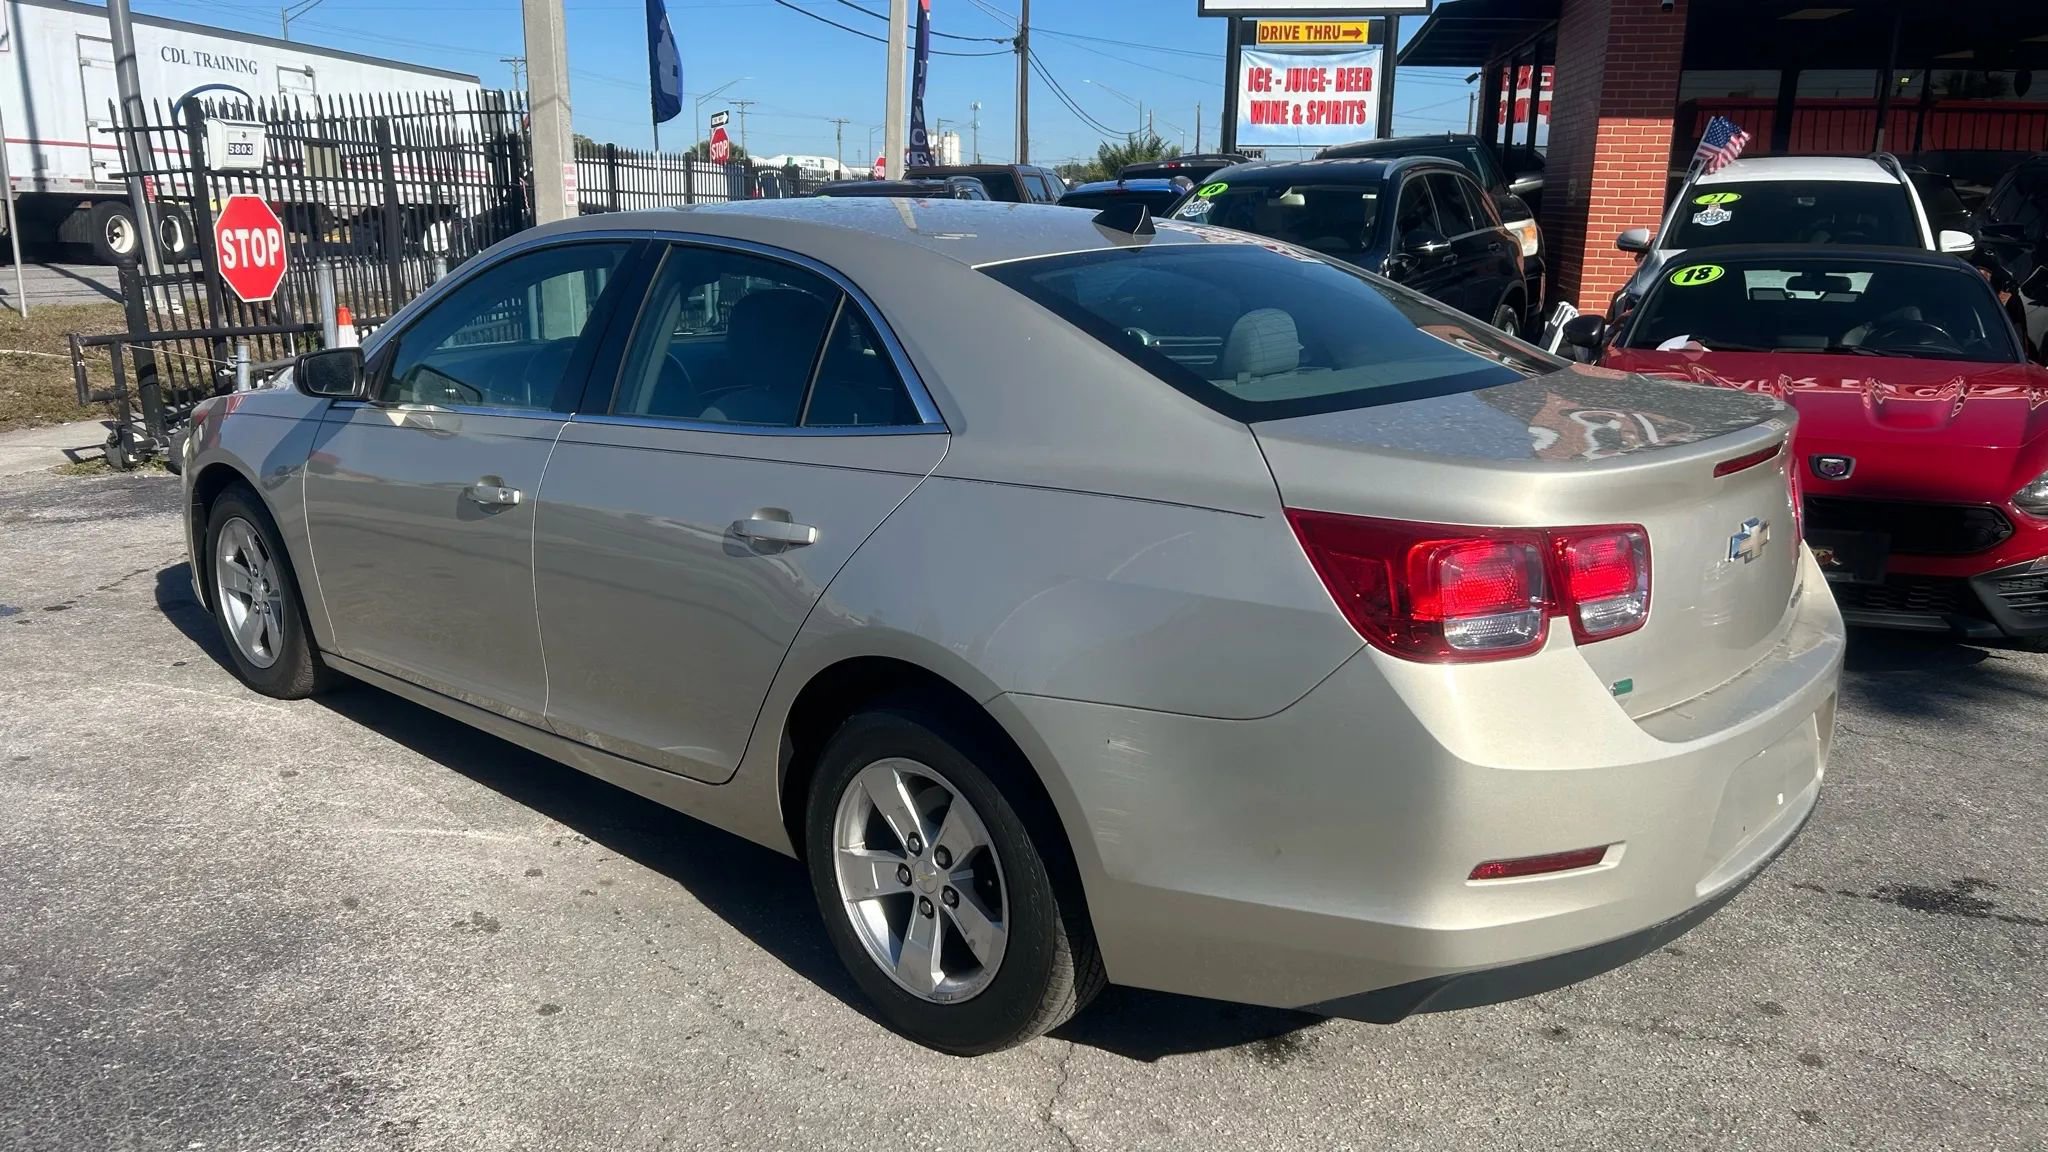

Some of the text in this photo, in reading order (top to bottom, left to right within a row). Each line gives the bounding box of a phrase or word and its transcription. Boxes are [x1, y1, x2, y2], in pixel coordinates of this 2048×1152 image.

[1260, 24, 1341, 41] DRIVE THRU
[161, 46, 258, 75] CDL TRAINING
[1248, 67, 1273, 92] ICE
[1335, 67, 1373, 92] BEER
[1250, 100, 1367, 125] WINE & SPIRITS
[228, 144, 253, 155] 5803
[711, 140, 728, 160] STOP
[1704, 193, 1728, 204] 21
[221, 227, 280, 269] STOP
[1682, 266, 1714, 283] 18
